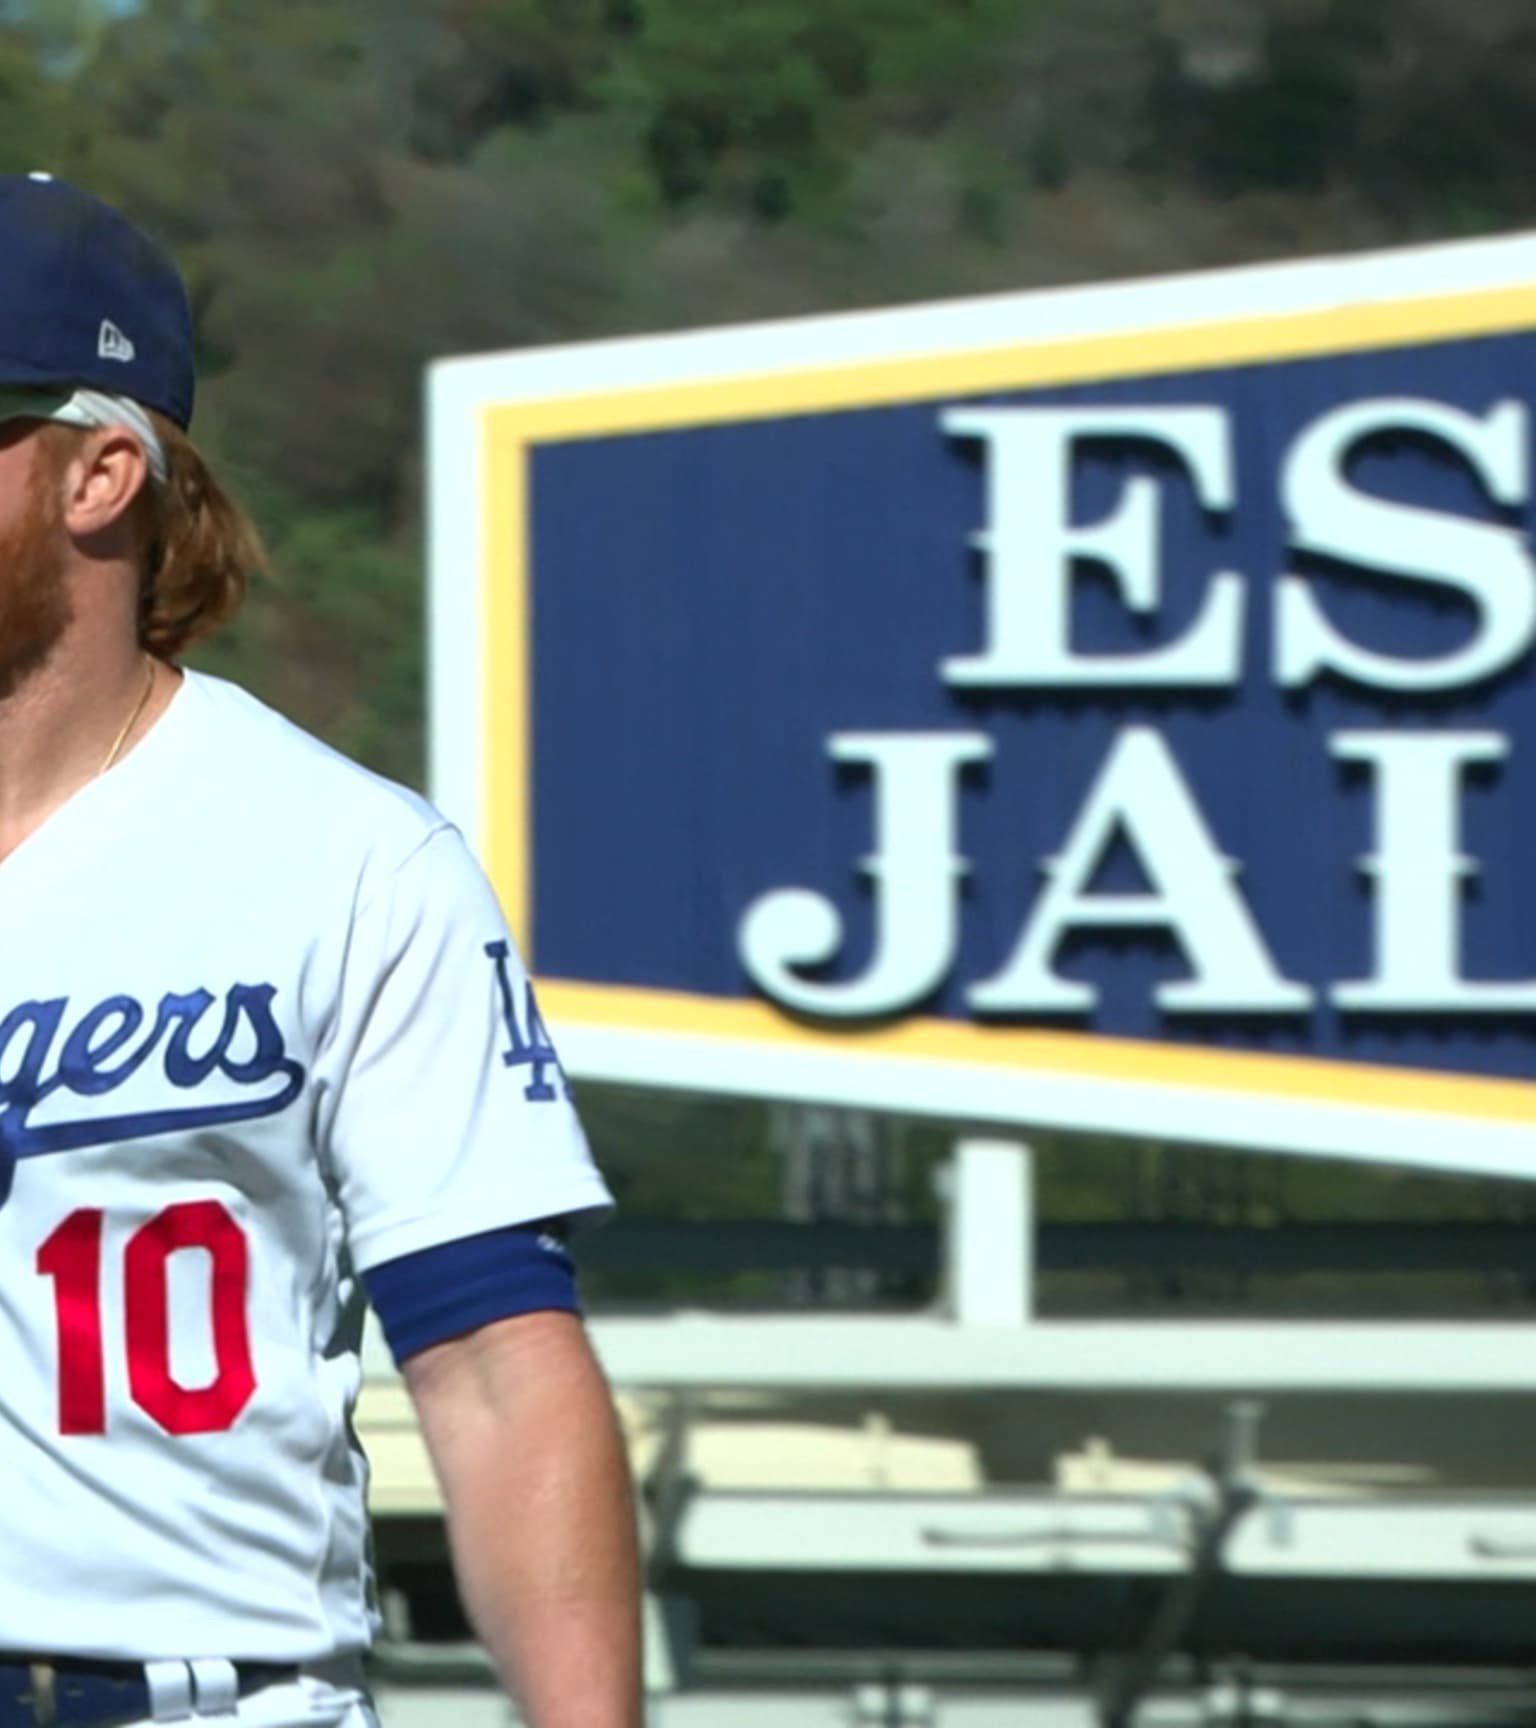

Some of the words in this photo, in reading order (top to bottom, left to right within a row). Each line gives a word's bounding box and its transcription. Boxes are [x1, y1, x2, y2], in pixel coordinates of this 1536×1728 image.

[938, 397, 1536, 692] ES
[737, 725, 1536, 1018] JAL
[37, 1199, 258, 1437] 10
